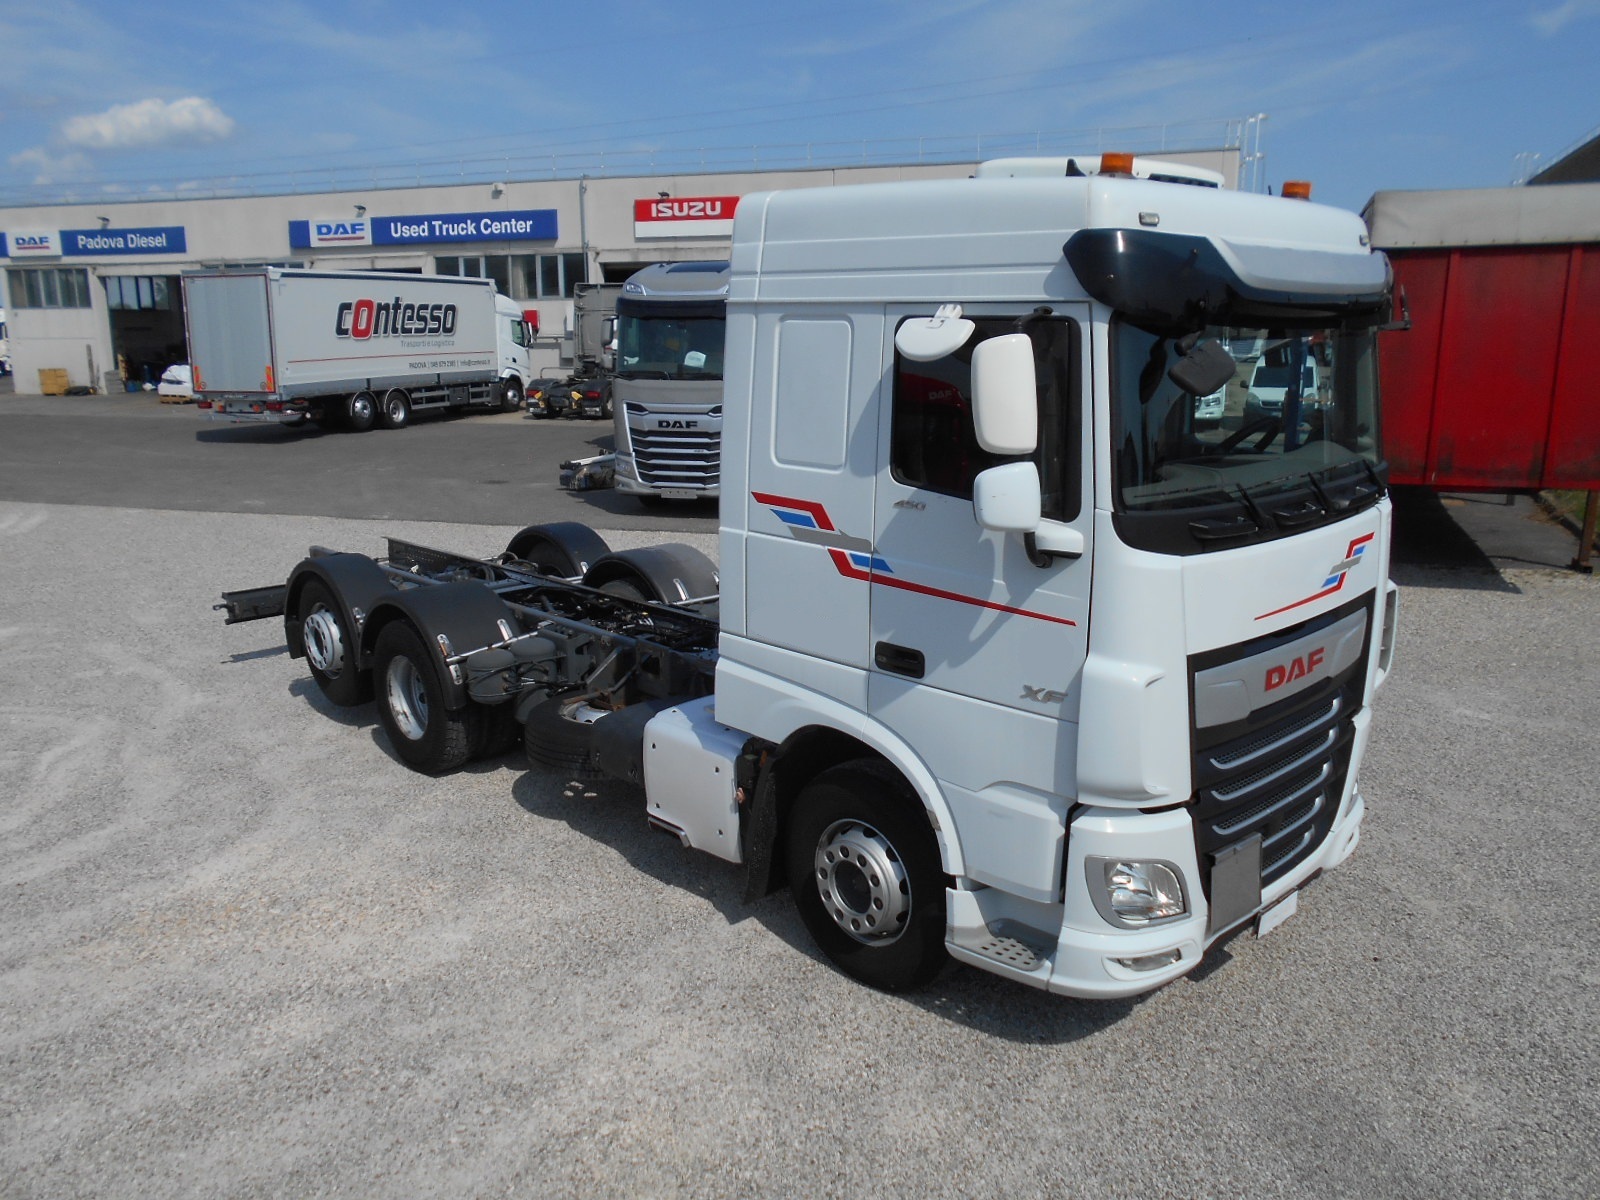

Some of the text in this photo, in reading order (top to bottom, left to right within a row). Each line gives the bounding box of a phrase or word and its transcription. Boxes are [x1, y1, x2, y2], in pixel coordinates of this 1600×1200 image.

[651, 201, 721, 217] ISUZU
[316, 222, 365, 236] DAF
[390, 218, 533, 237] Used Truck Center
[15, 236, 50, 246] DAF
[77, 233, 167, 249] Padova Diesel
[928, 390, 952, 400] DAF
[658, 420, 698, 429] DAF
[1264, 646, 1325, 692] DAF
[1019, 684, 1068, 704] XF
